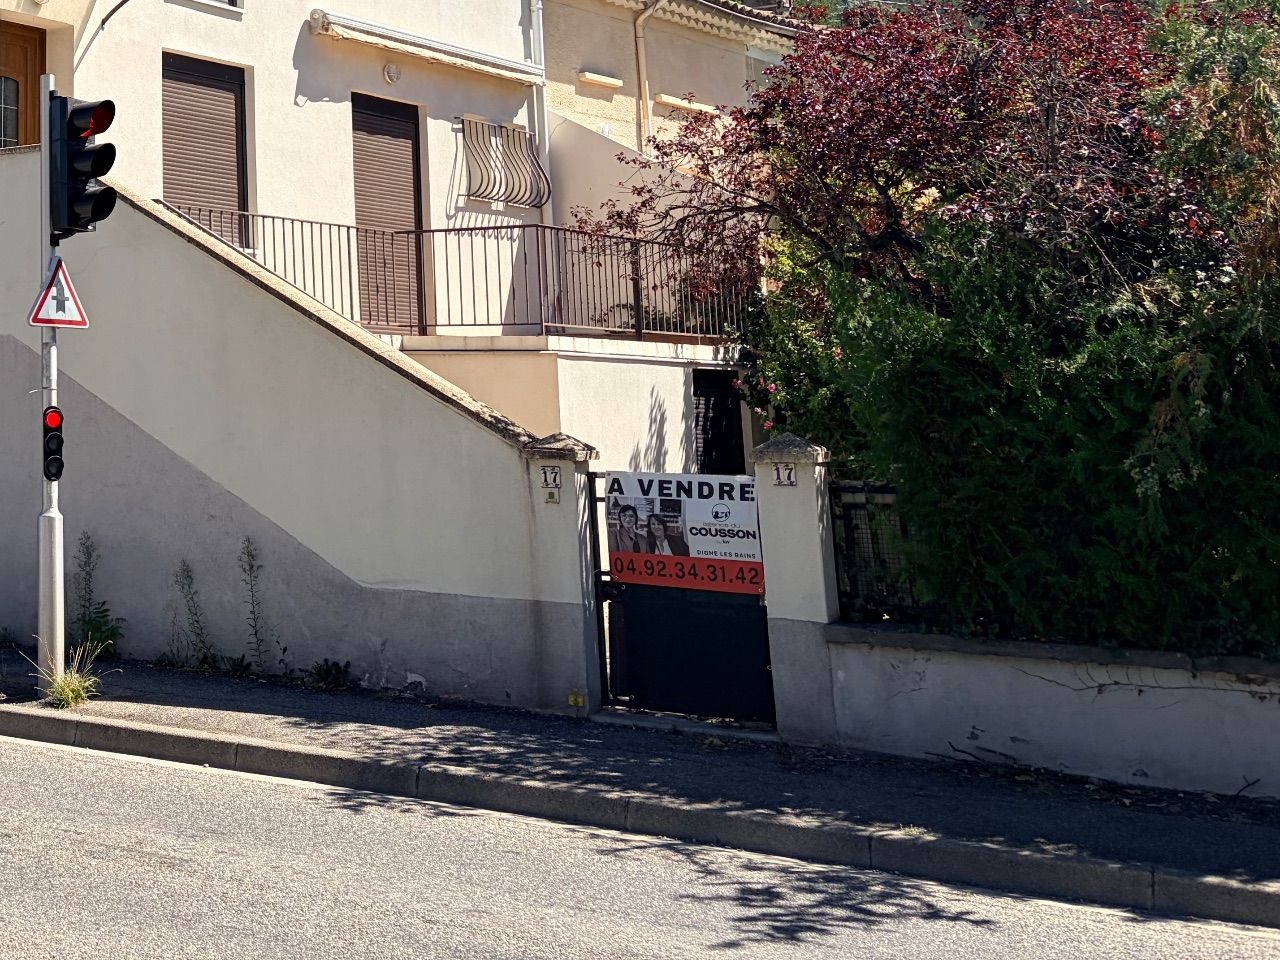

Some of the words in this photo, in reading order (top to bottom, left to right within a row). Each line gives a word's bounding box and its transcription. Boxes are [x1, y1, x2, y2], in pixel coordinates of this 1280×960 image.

[542, 470, 558, 484] 17
[775, 467, 793, 481] 17
[608, 477, 624, 495] A
[637, 478, 755, 502] VENDRE
[689, 527, 757, 540] COUSSON
[696, 549, 718, 557] DIGNE
[734, 552, 756, 560] BAINS
[613, 556, 760, 585] 04.92.34.31.42
